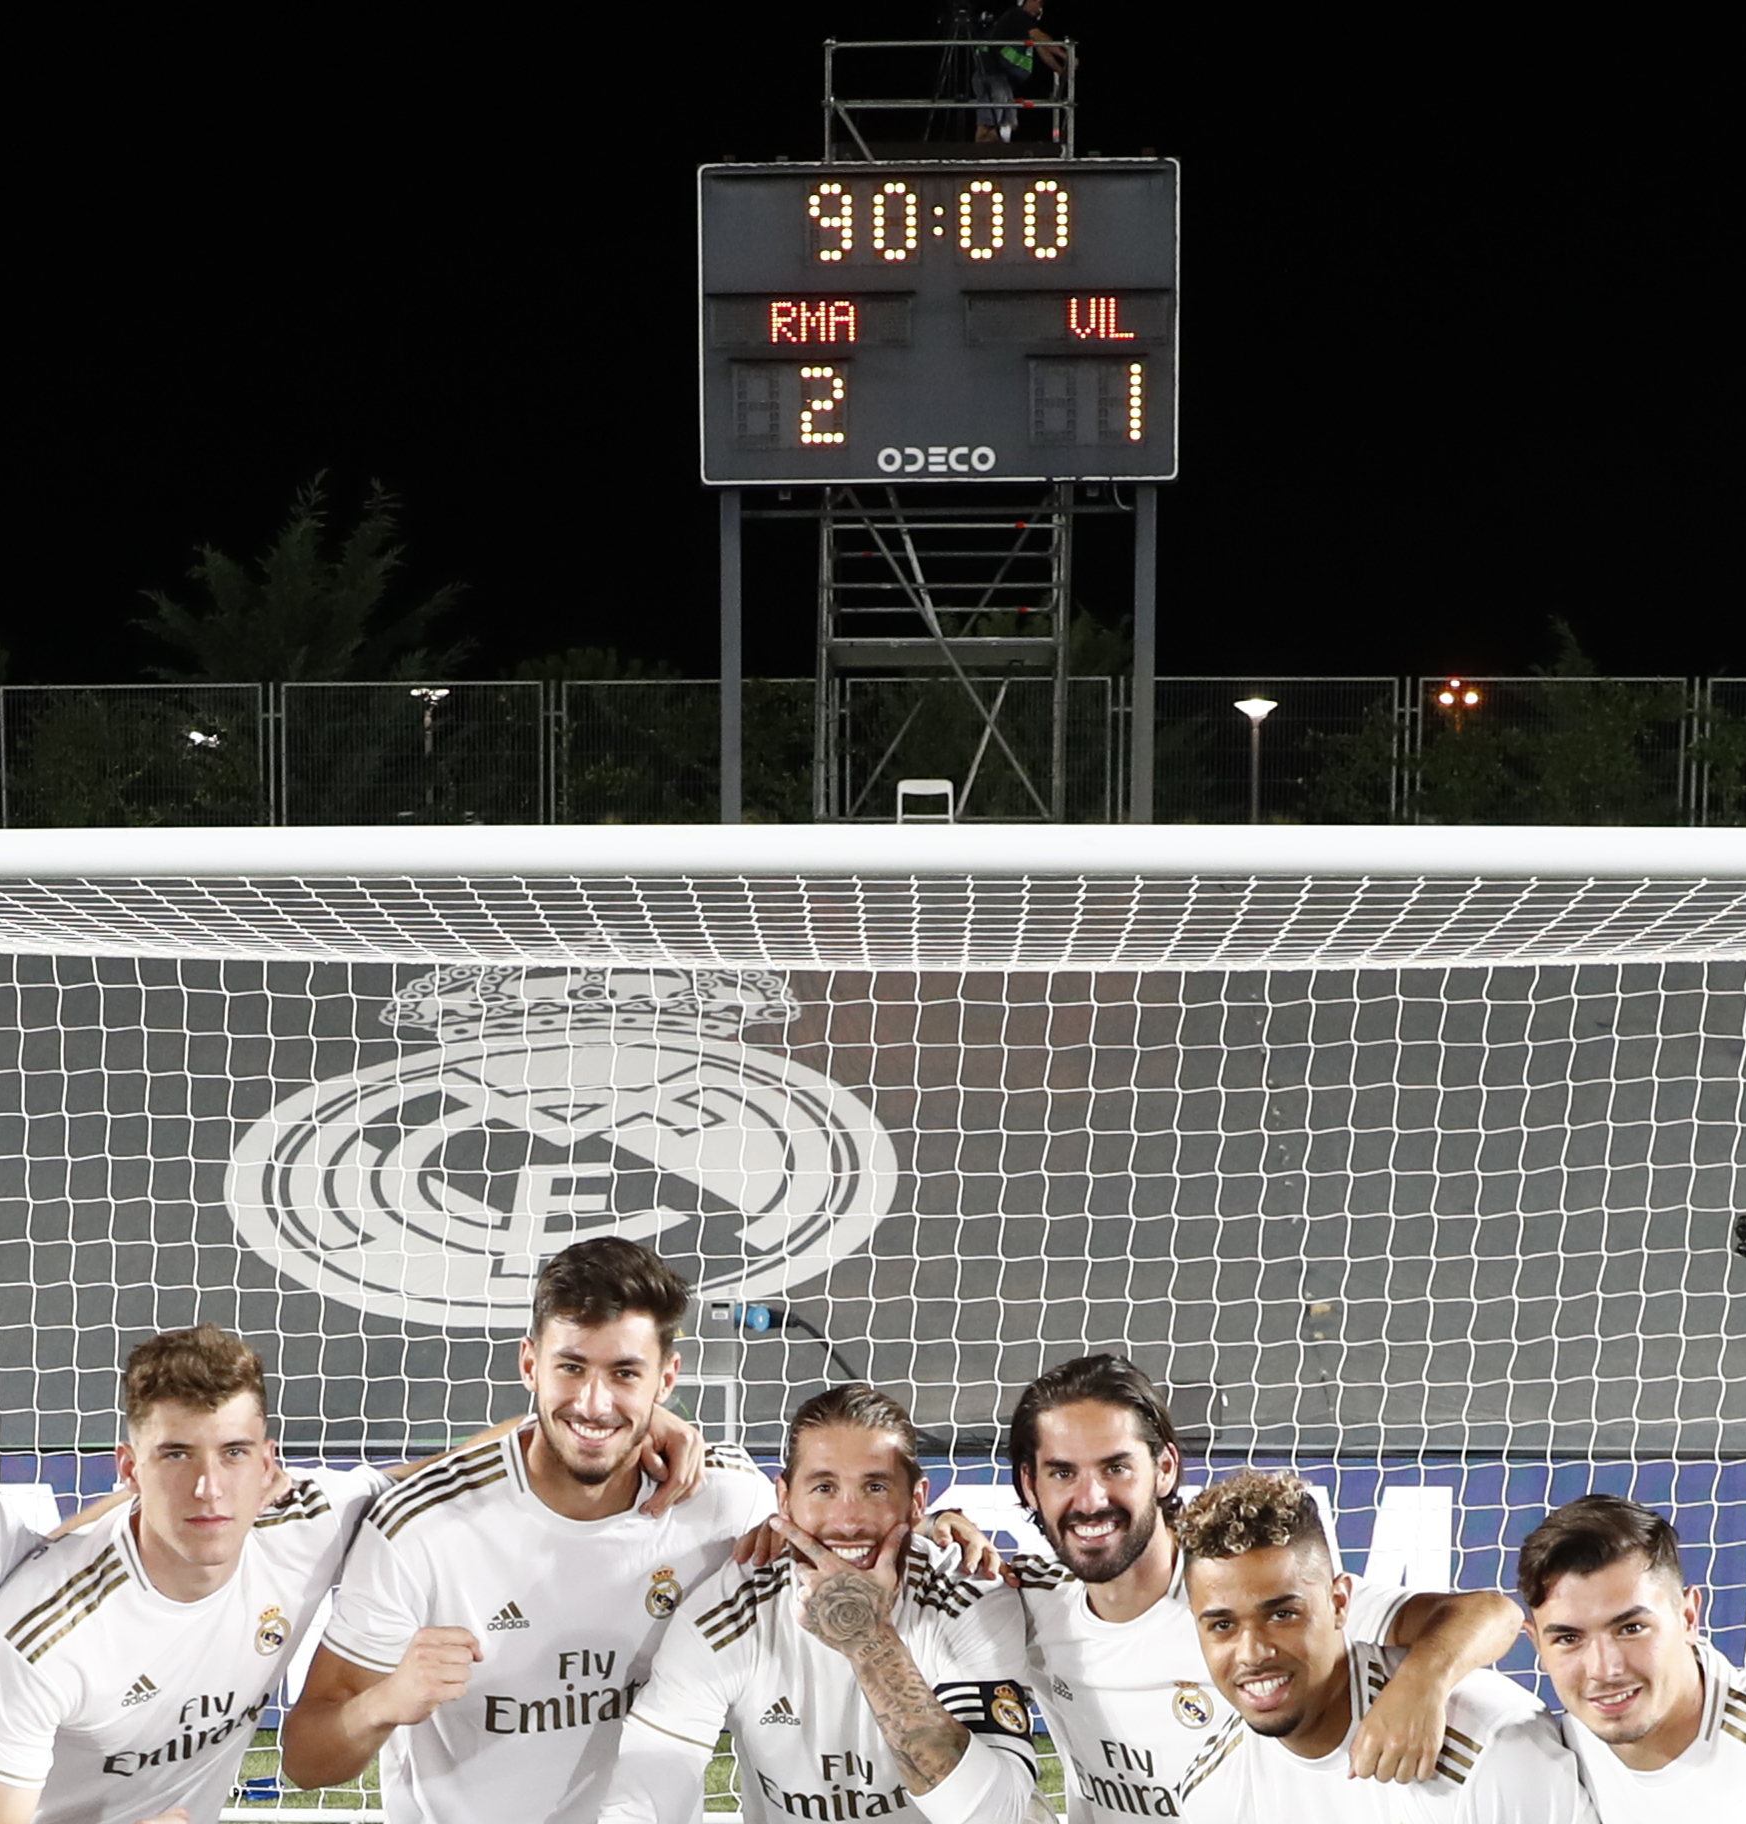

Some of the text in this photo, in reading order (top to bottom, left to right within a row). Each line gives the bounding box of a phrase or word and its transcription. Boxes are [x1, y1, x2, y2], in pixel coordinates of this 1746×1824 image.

[809, 179, 1070, 262] 90:00
[769, 300, 857, 343] RMA
[1068, 295, 1137, 340] VIL
[799, 365, 846, 445] 2
[1127, 361, 1144, 442] 1
[876, 446, 997, 473] ODECO
[487, 1618, 531, 1631] adidas
[559, 1650, 616, 1680] Fly
[179, 1691, 235, 1724] Fly
[484, 1677, 650, 1735] Emirat
[759, 1712, 801, 1726] adidas
[821, 1750, 874, 1786] Fly
[1100, 1739, 1154, 1778] Fly
[755, 1768, 908, 1822] Emirat
[1070, 1755, 1181, 1817] Emira
